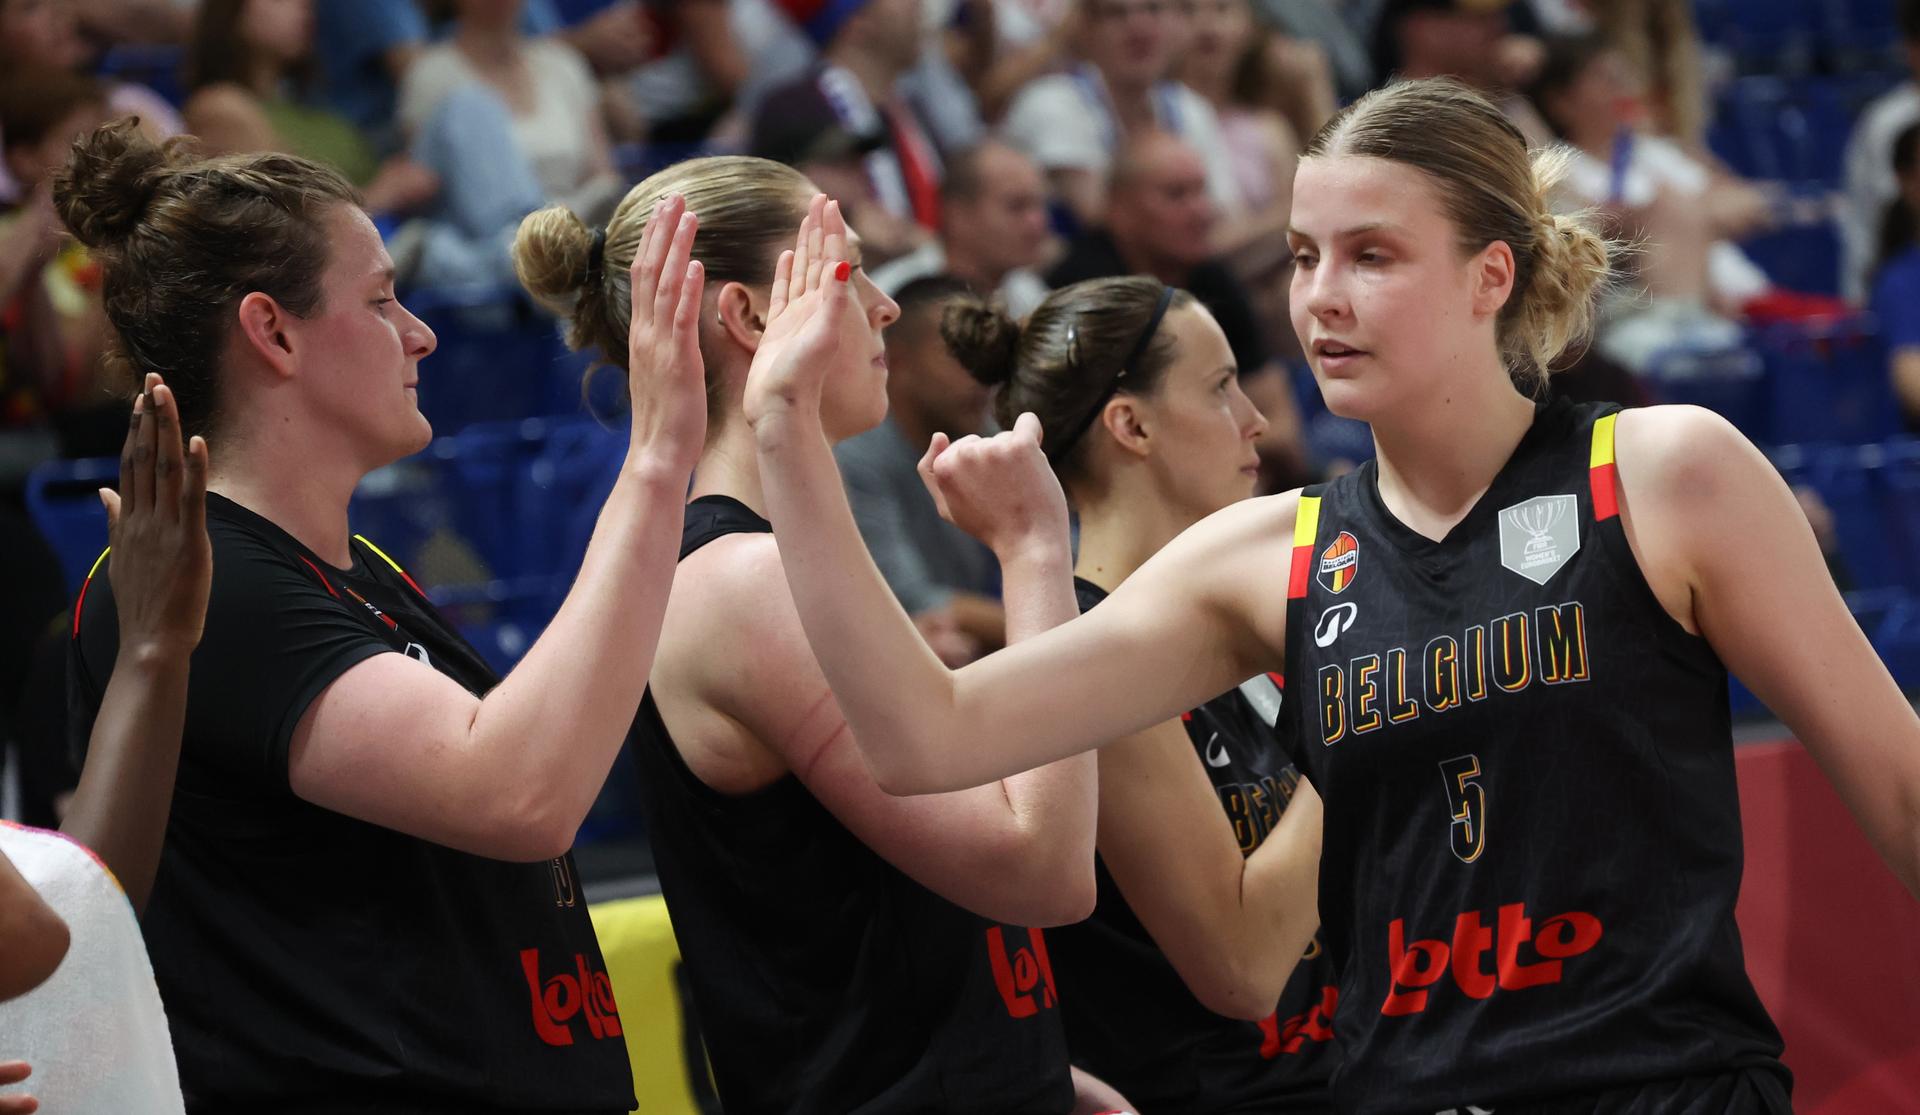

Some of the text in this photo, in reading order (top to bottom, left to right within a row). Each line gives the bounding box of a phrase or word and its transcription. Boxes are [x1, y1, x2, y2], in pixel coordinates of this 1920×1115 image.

[1318, 601, 1590, 746] BELGIUM
[1438, 754, 1486, 864] 5
[1381, 902, 1603, 1017] lotto
